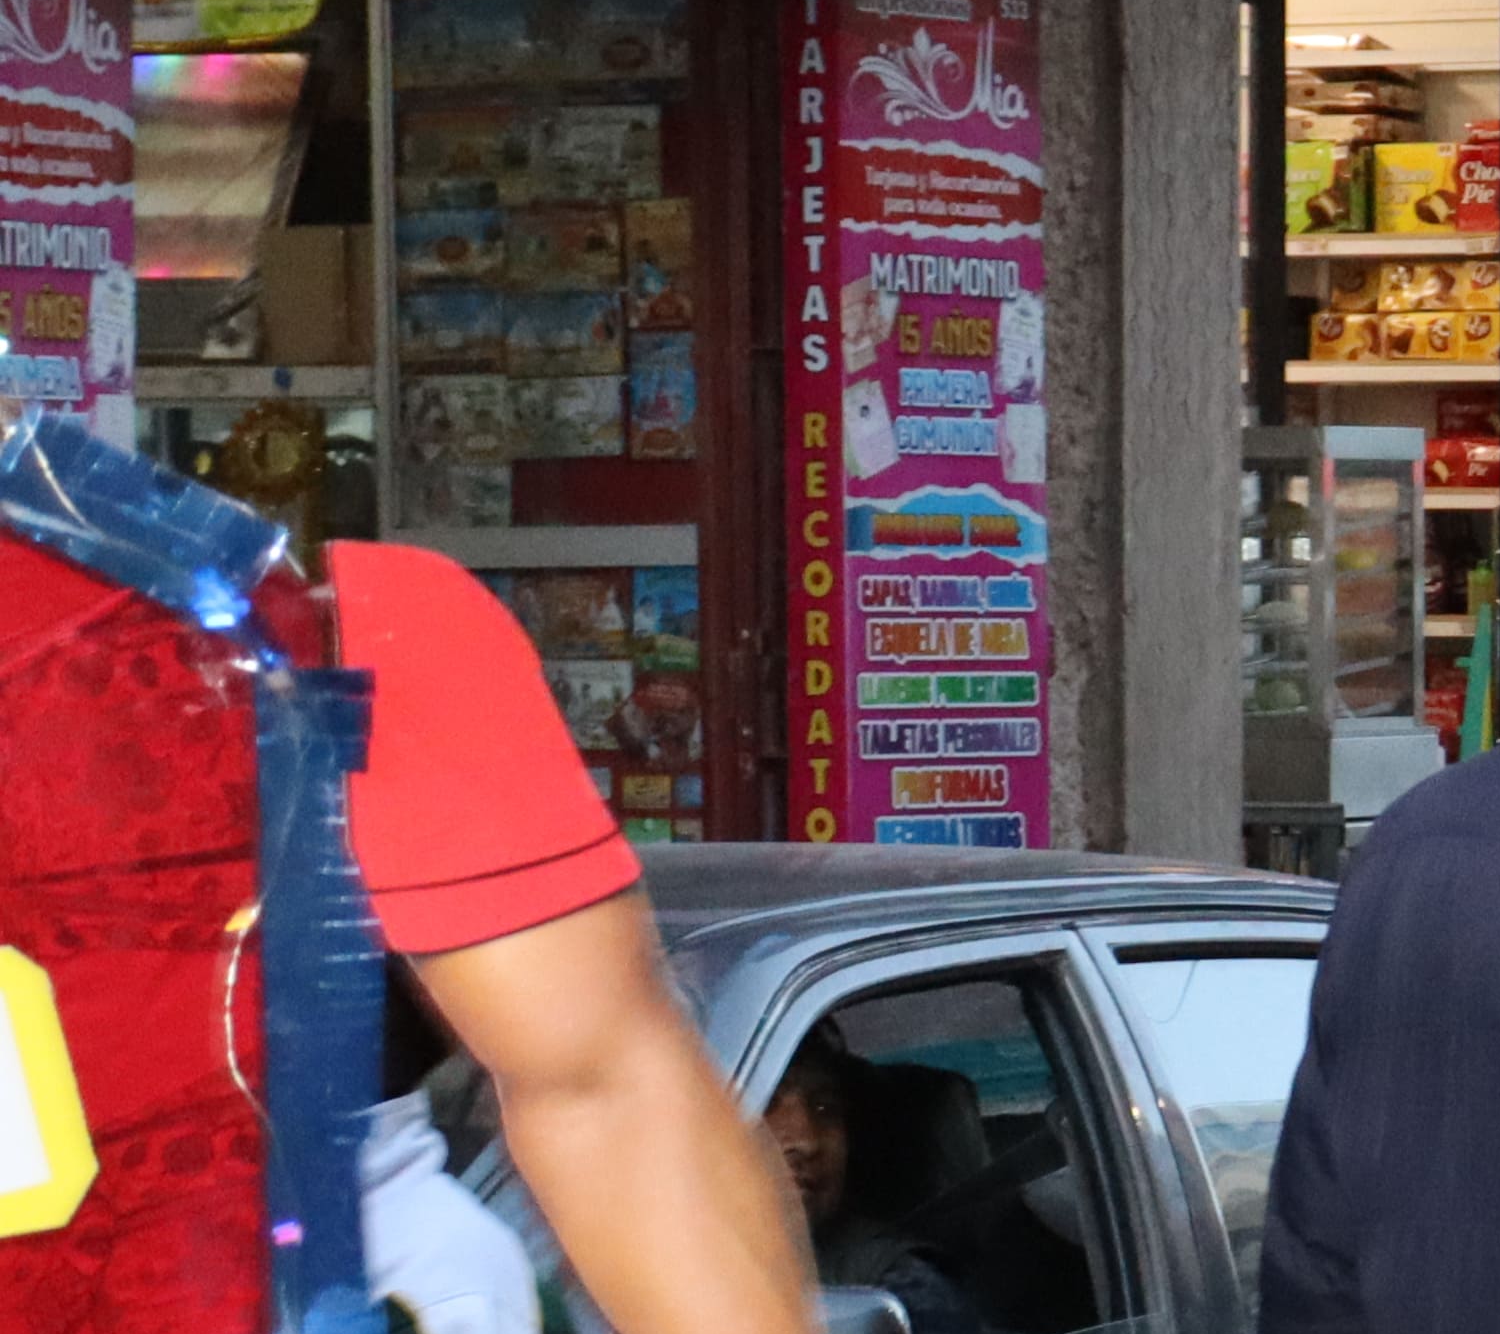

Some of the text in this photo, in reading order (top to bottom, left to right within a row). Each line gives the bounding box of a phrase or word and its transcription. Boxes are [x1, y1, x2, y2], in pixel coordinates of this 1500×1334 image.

[1460, 183, 1496, 205] Pie
[870, 251, 1021, 300] MATRIMONIO
[929, 306, 994, 359] AÑOS
[899, 368, 994, 409] PRIMERA
[895, 409, 1000, 456] COMUNIÓN
[860, 721, 940, 757] TARJETAS
